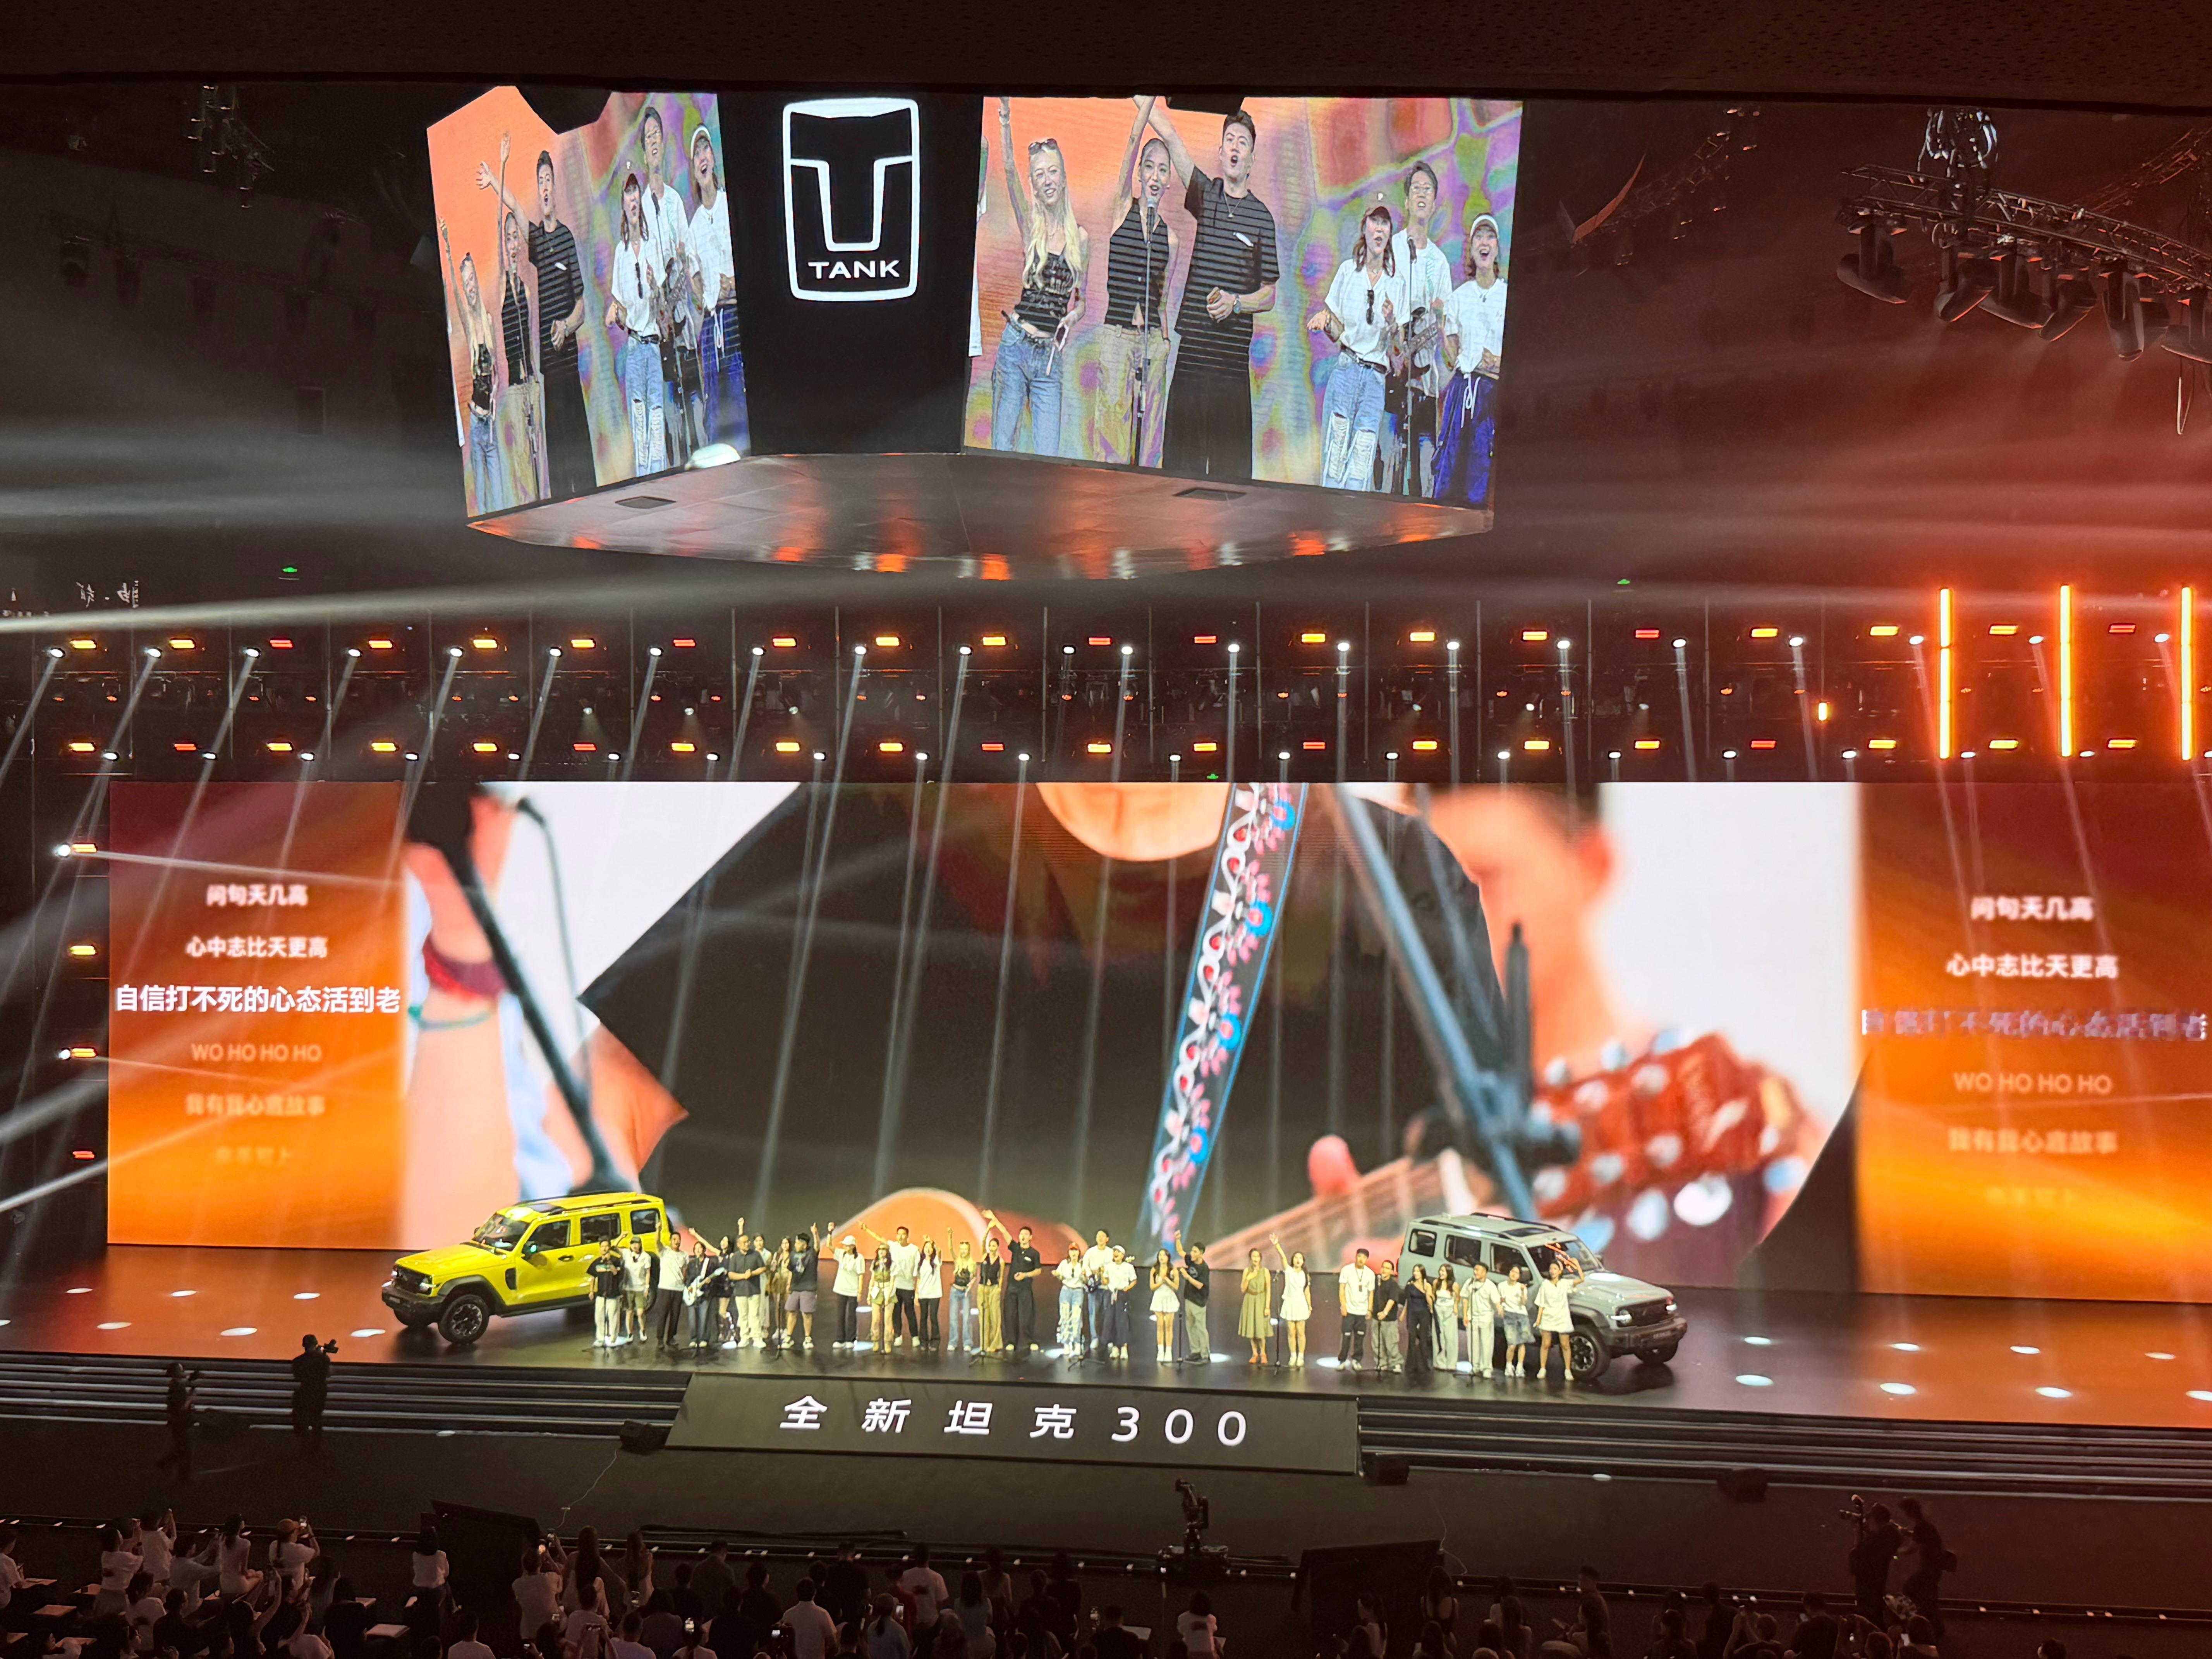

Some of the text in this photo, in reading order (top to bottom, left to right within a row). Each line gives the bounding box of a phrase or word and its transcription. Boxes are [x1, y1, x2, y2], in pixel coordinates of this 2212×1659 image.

[808, 260, 900, 279] TANK
[186, 935, 328, 958] 心中志比天更高
[1946, 953, 2119, 979] 心中志比天更高
[115, 984, 401, 1013] 自信打不死的心态活到老
[191, 1043, 323, 1063] WO HO HO HO
[1953, 1072, 2113, 1096] WO HO HO HO
[779, 1395, 1247, 1446] 全新坦克300
